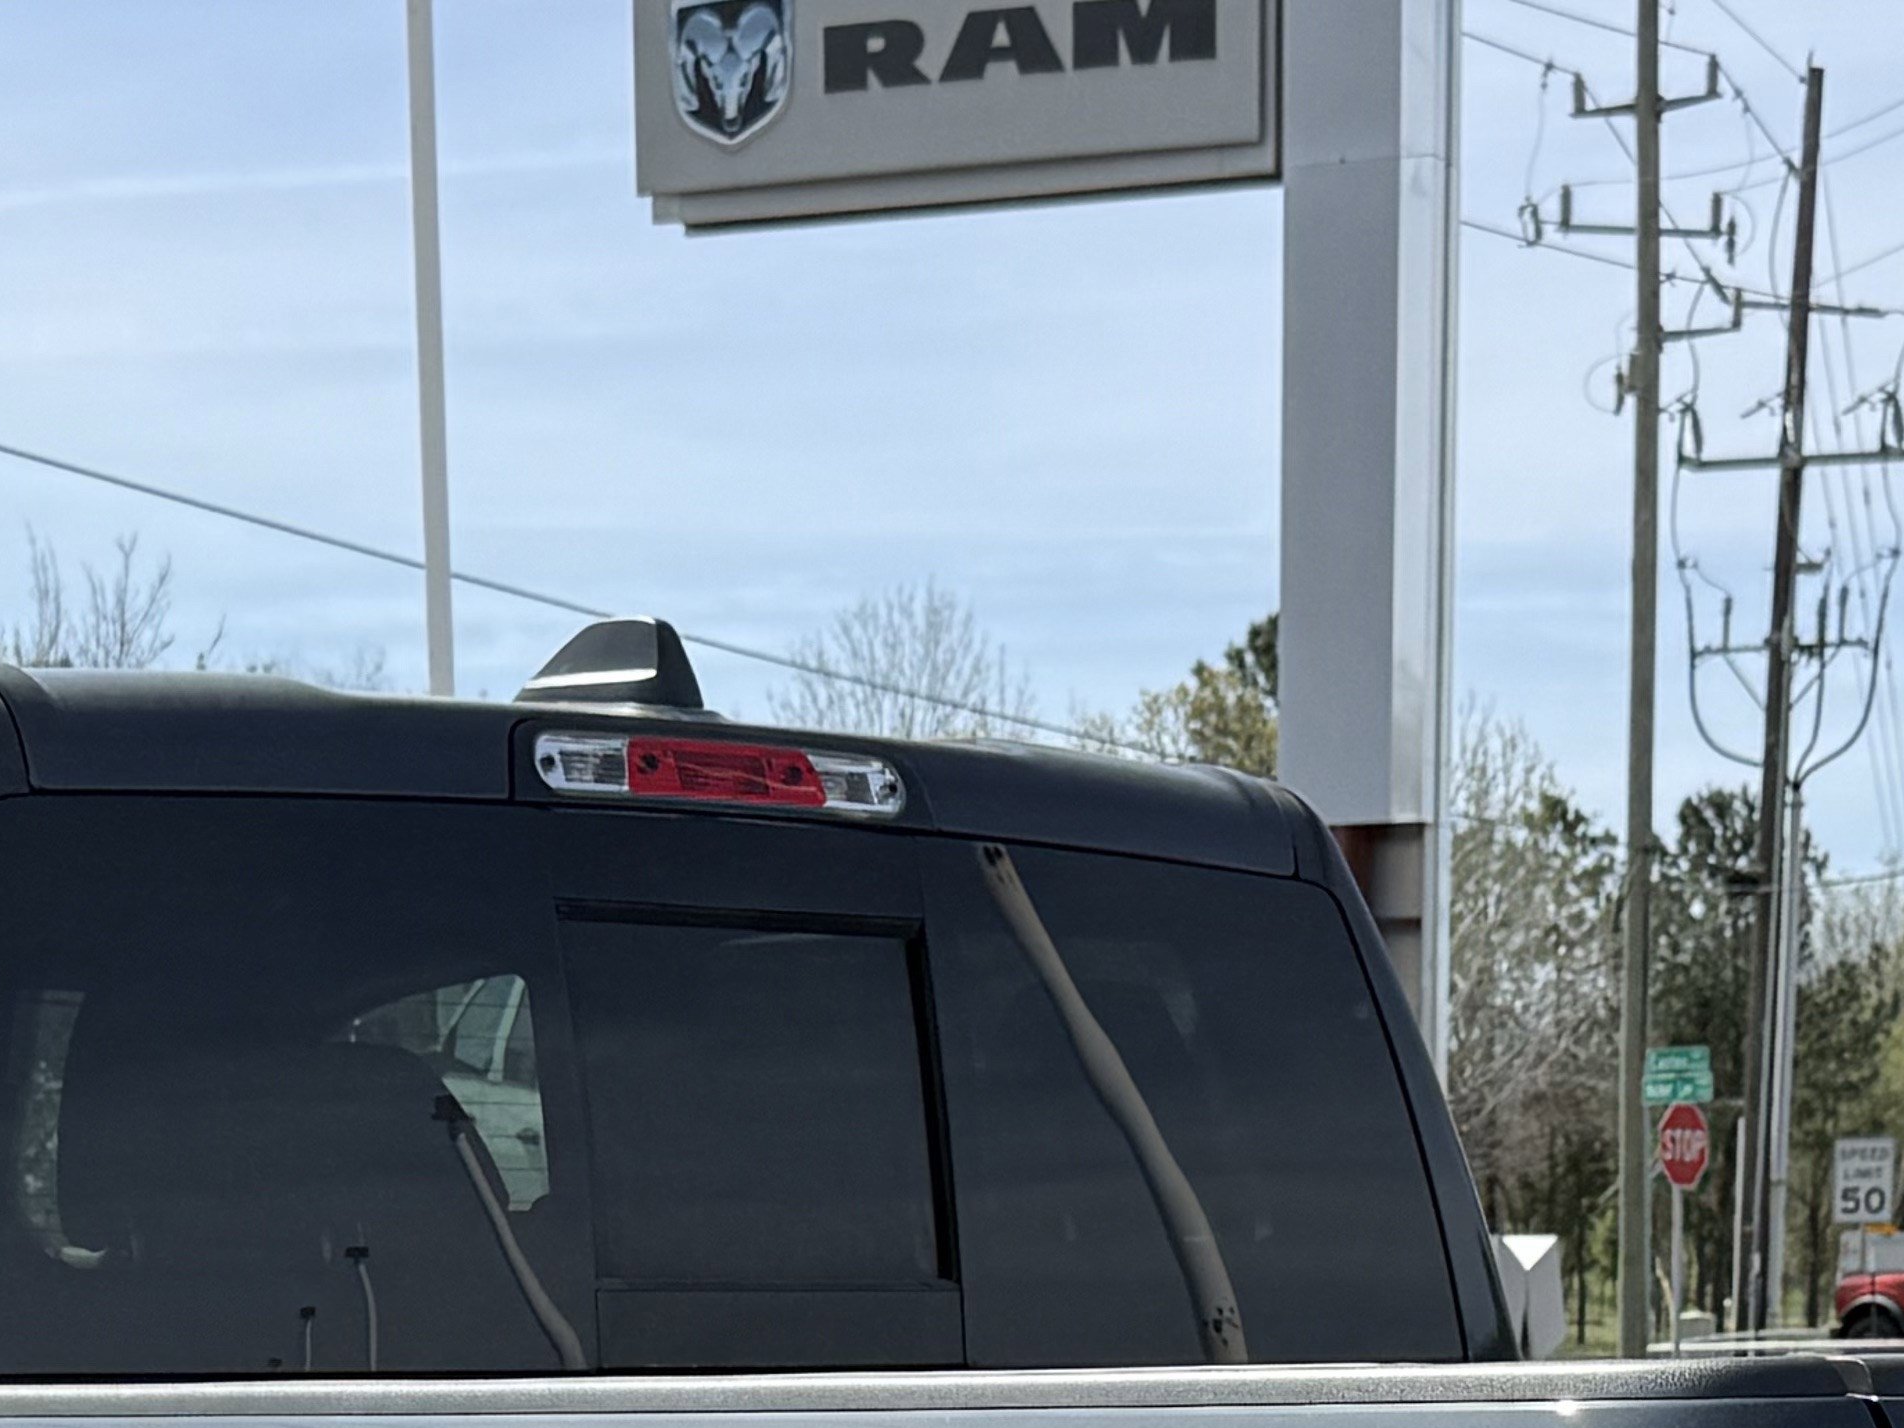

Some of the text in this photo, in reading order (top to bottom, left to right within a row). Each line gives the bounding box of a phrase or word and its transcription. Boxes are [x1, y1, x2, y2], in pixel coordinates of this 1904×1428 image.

[823, 0, 1217, 94] RAM
[1661, 1128, 1706, 1162] STOP
[1841, 1186, 1886, 1215] 50
